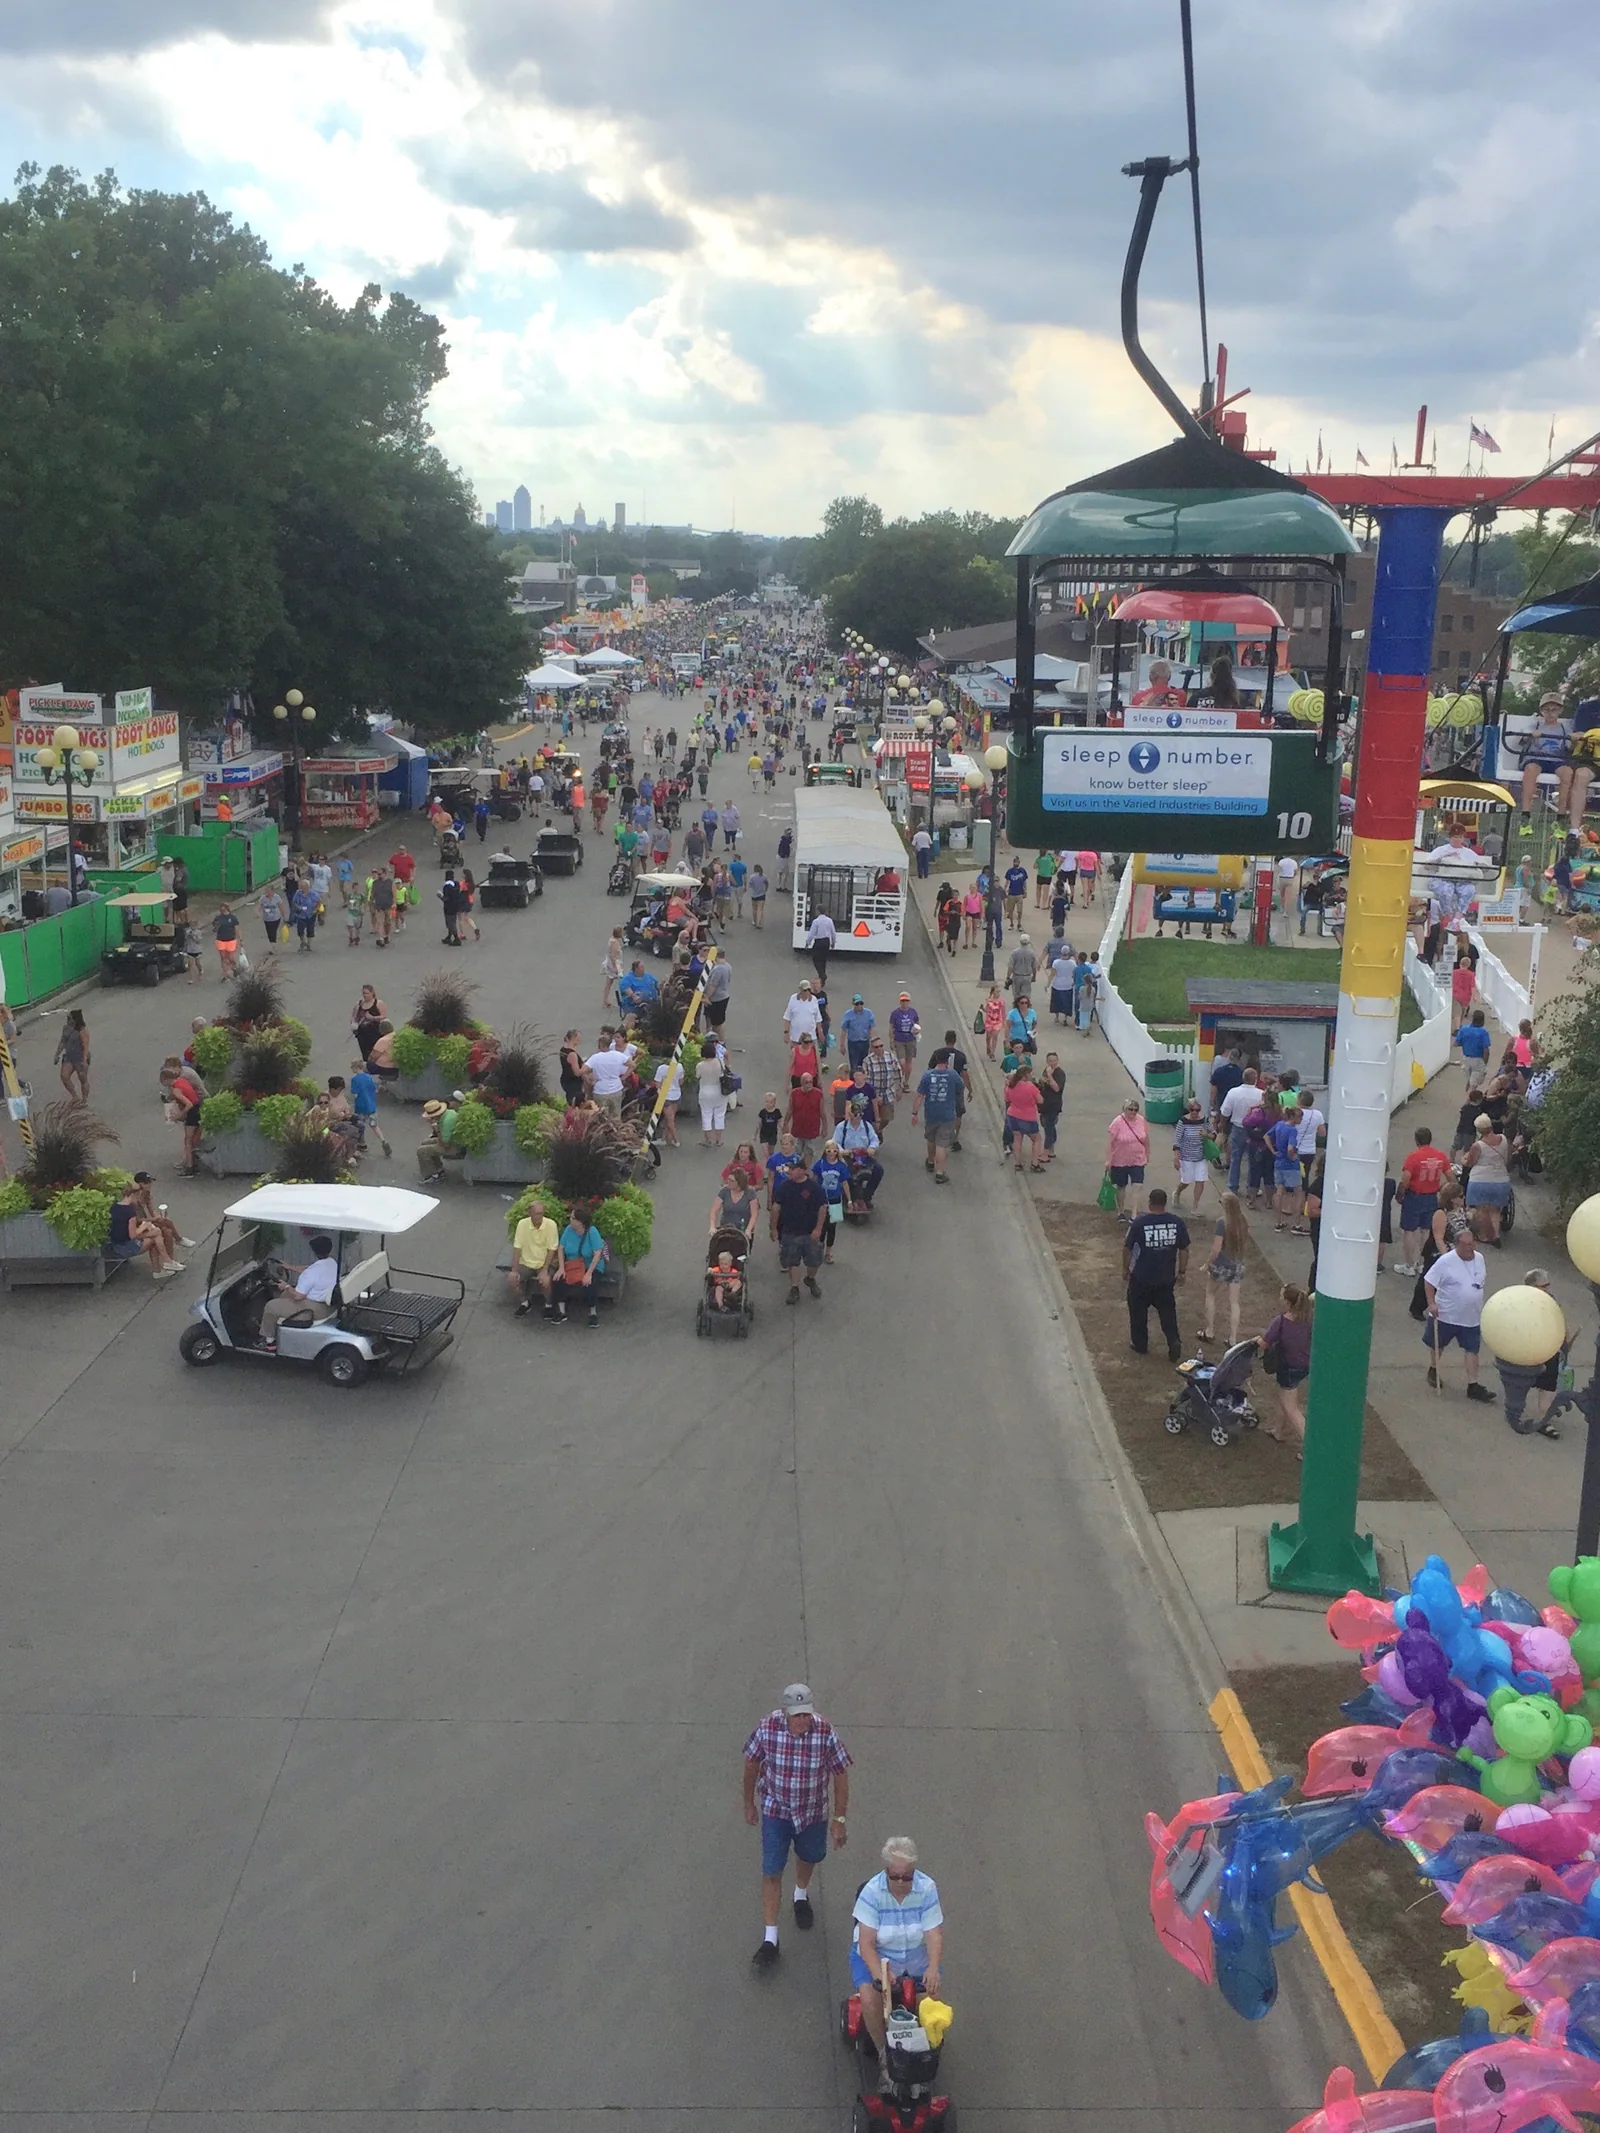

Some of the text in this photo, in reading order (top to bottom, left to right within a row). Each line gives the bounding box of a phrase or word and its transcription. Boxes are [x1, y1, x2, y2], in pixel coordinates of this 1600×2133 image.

[29, 698, 96, 710] PICKLE DAWG
[1133, 713, 1228, 726] sleep number
[16, 728, 54, 746] FOOT
[116, 715, 177, 748] FOOT LONGS
[893, 732, 914, 741] ROOT
[128, 739, 165, 758] HOT DOGS
[1061, 745, 1252, 768] sleep number
[1089, 777, 1208, 794] know better sleep
[103, 796, 142, 807] PICKLE
[1050, 798, 1258, 813] Visit us in the Varied Industries Building
[17, 802, 92, 814] JUMBO OG
[109, 805, 137, 814] DAWG
[1277, 811, 1312, 839] 10
[1220, 872, 1233, 883] 12
[1483, 915, 1514, 923] ENTRANCE
[885, 923, 892, 931] 3
[1529, 963, 1537, 1005] ENTRANCE
[1144, 1229, 1177, 1241] FIRE
